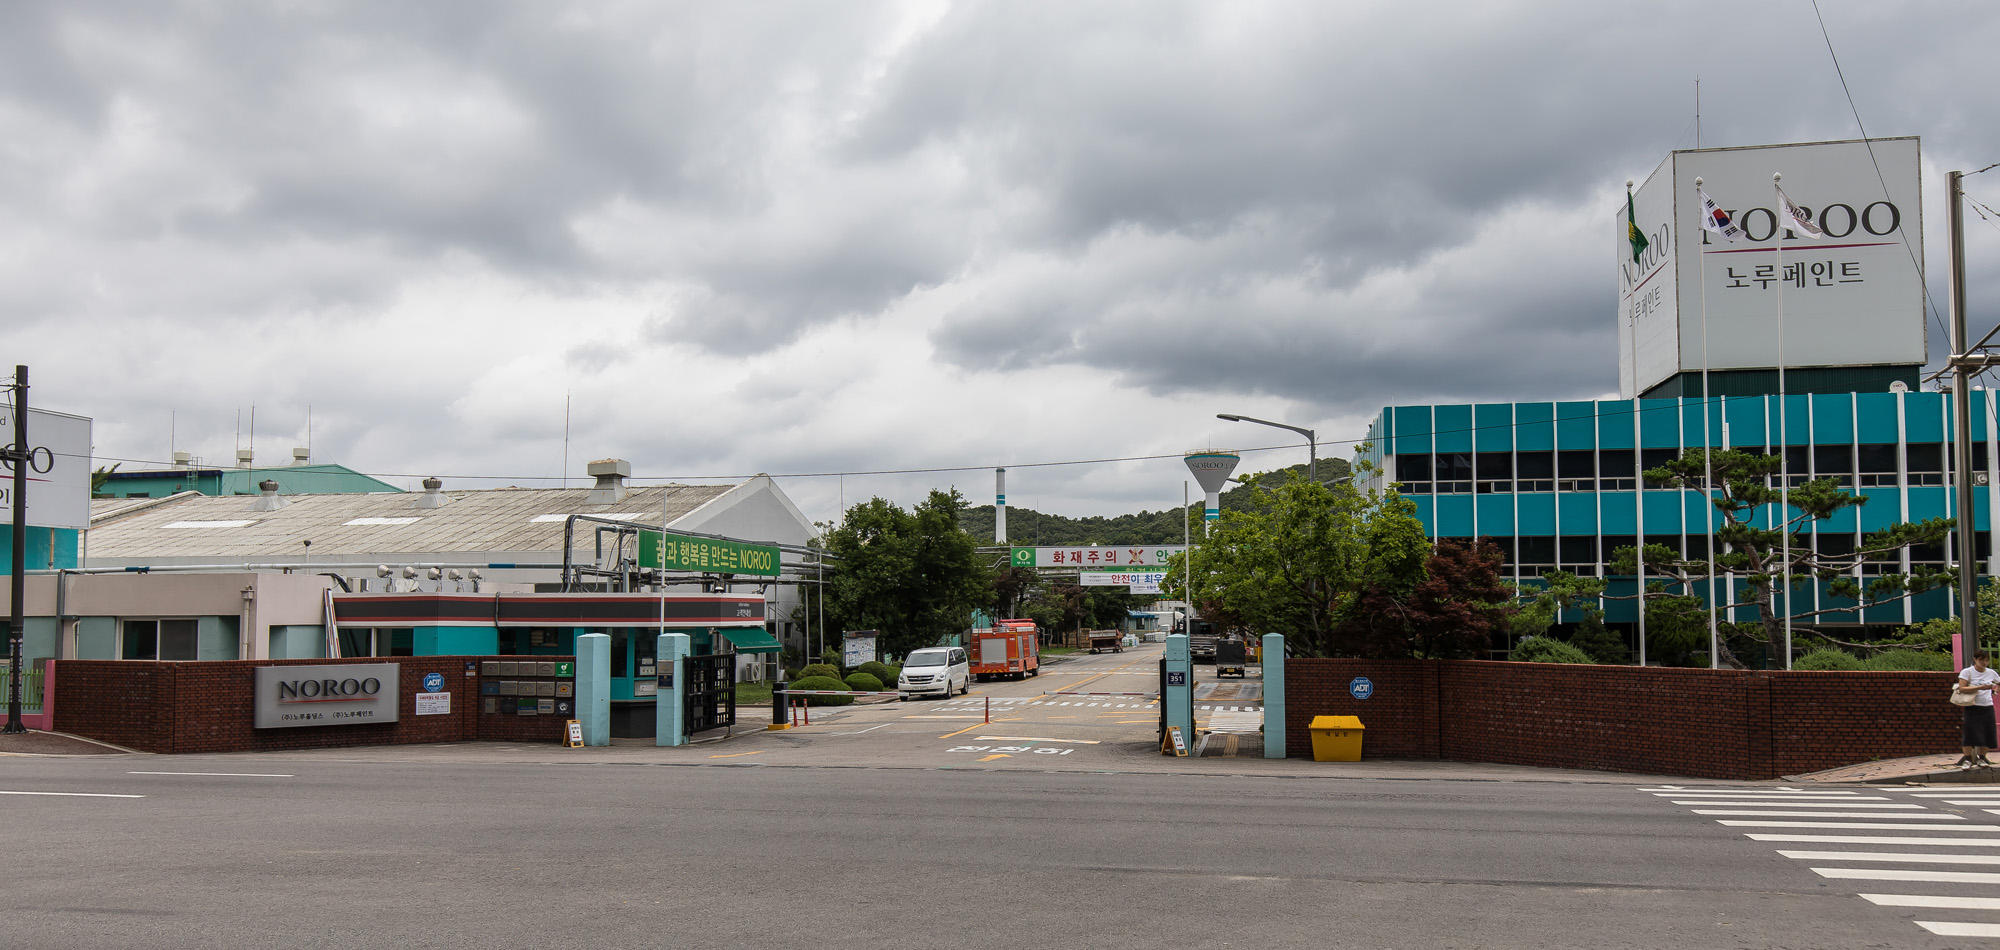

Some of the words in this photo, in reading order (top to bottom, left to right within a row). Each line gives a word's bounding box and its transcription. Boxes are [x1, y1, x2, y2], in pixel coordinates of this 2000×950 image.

[1726, 260, 1864, 289] 노루페인트
[680, 542, 709, 567] 행복을
[712, 546, 738, 568] 만드는
[740, 549, 772, 570] NOROO
[1111, 574, 1140, 584] 안전이
[279, 677, 381, 699] NOROO
[427, 679, 441, 687] ADT
[1354, 684, 1369, 692] ADT
[332, 710, 374, 719] (주)노루페인트
[945, 745, 1075, 756] 천천히
